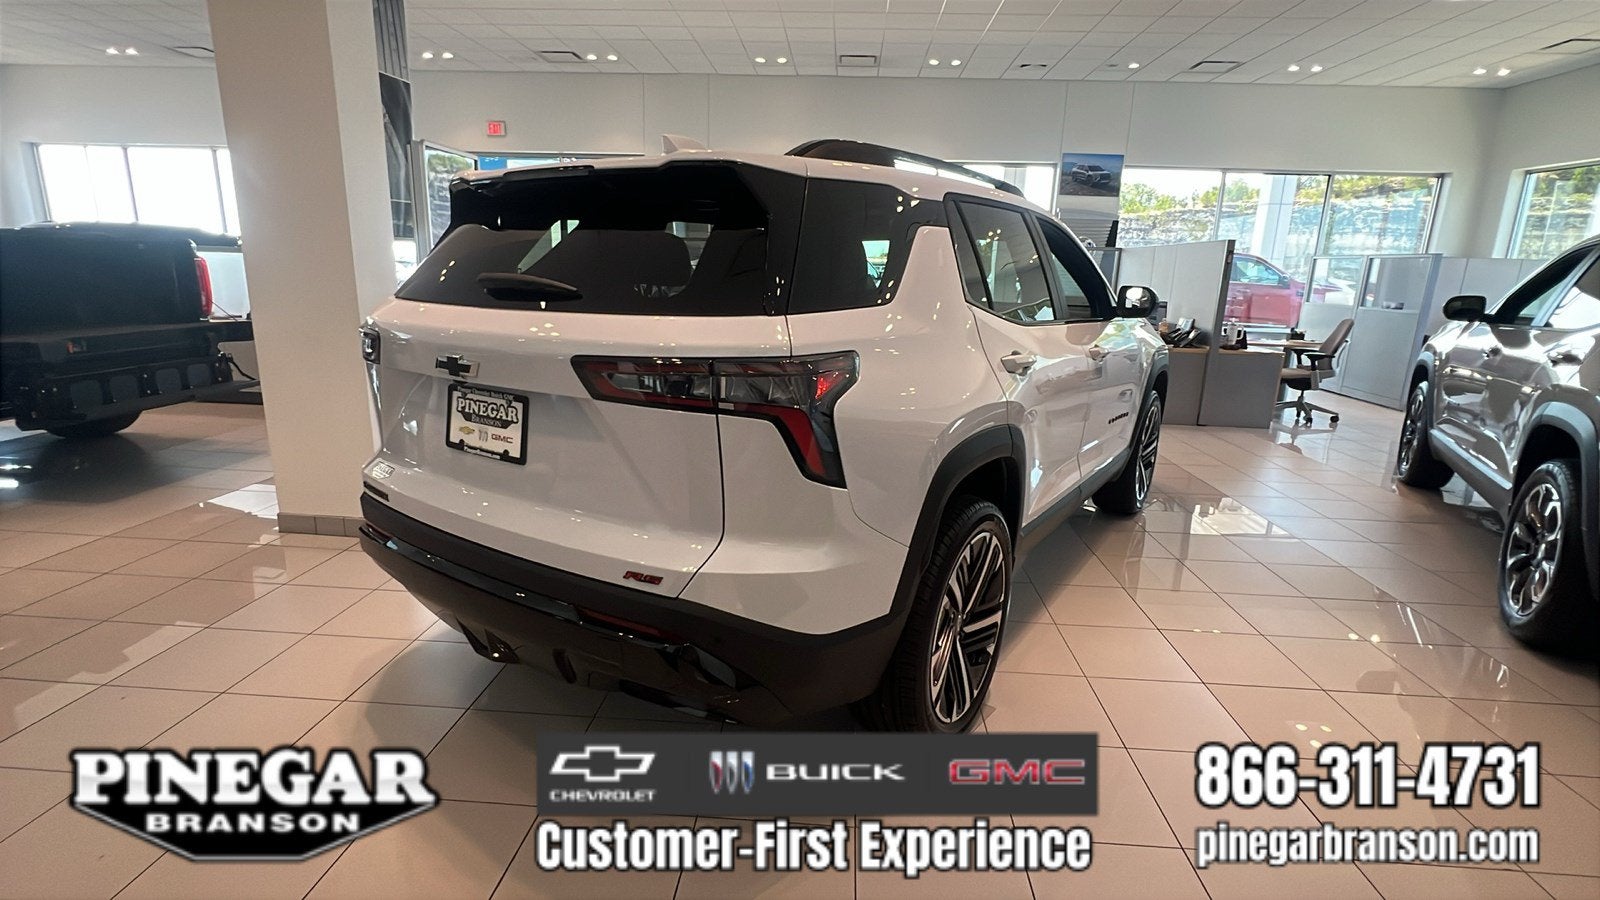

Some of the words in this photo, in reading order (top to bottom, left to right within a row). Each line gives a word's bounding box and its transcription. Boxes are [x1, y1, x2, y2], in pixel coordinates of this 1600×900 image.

[457, 397, 519, 424] PINEGAR
[471, 413, 502, 427] BRANSON
[491, 433, 514, 444] GMC
[622, 570, 664, 585] RS
